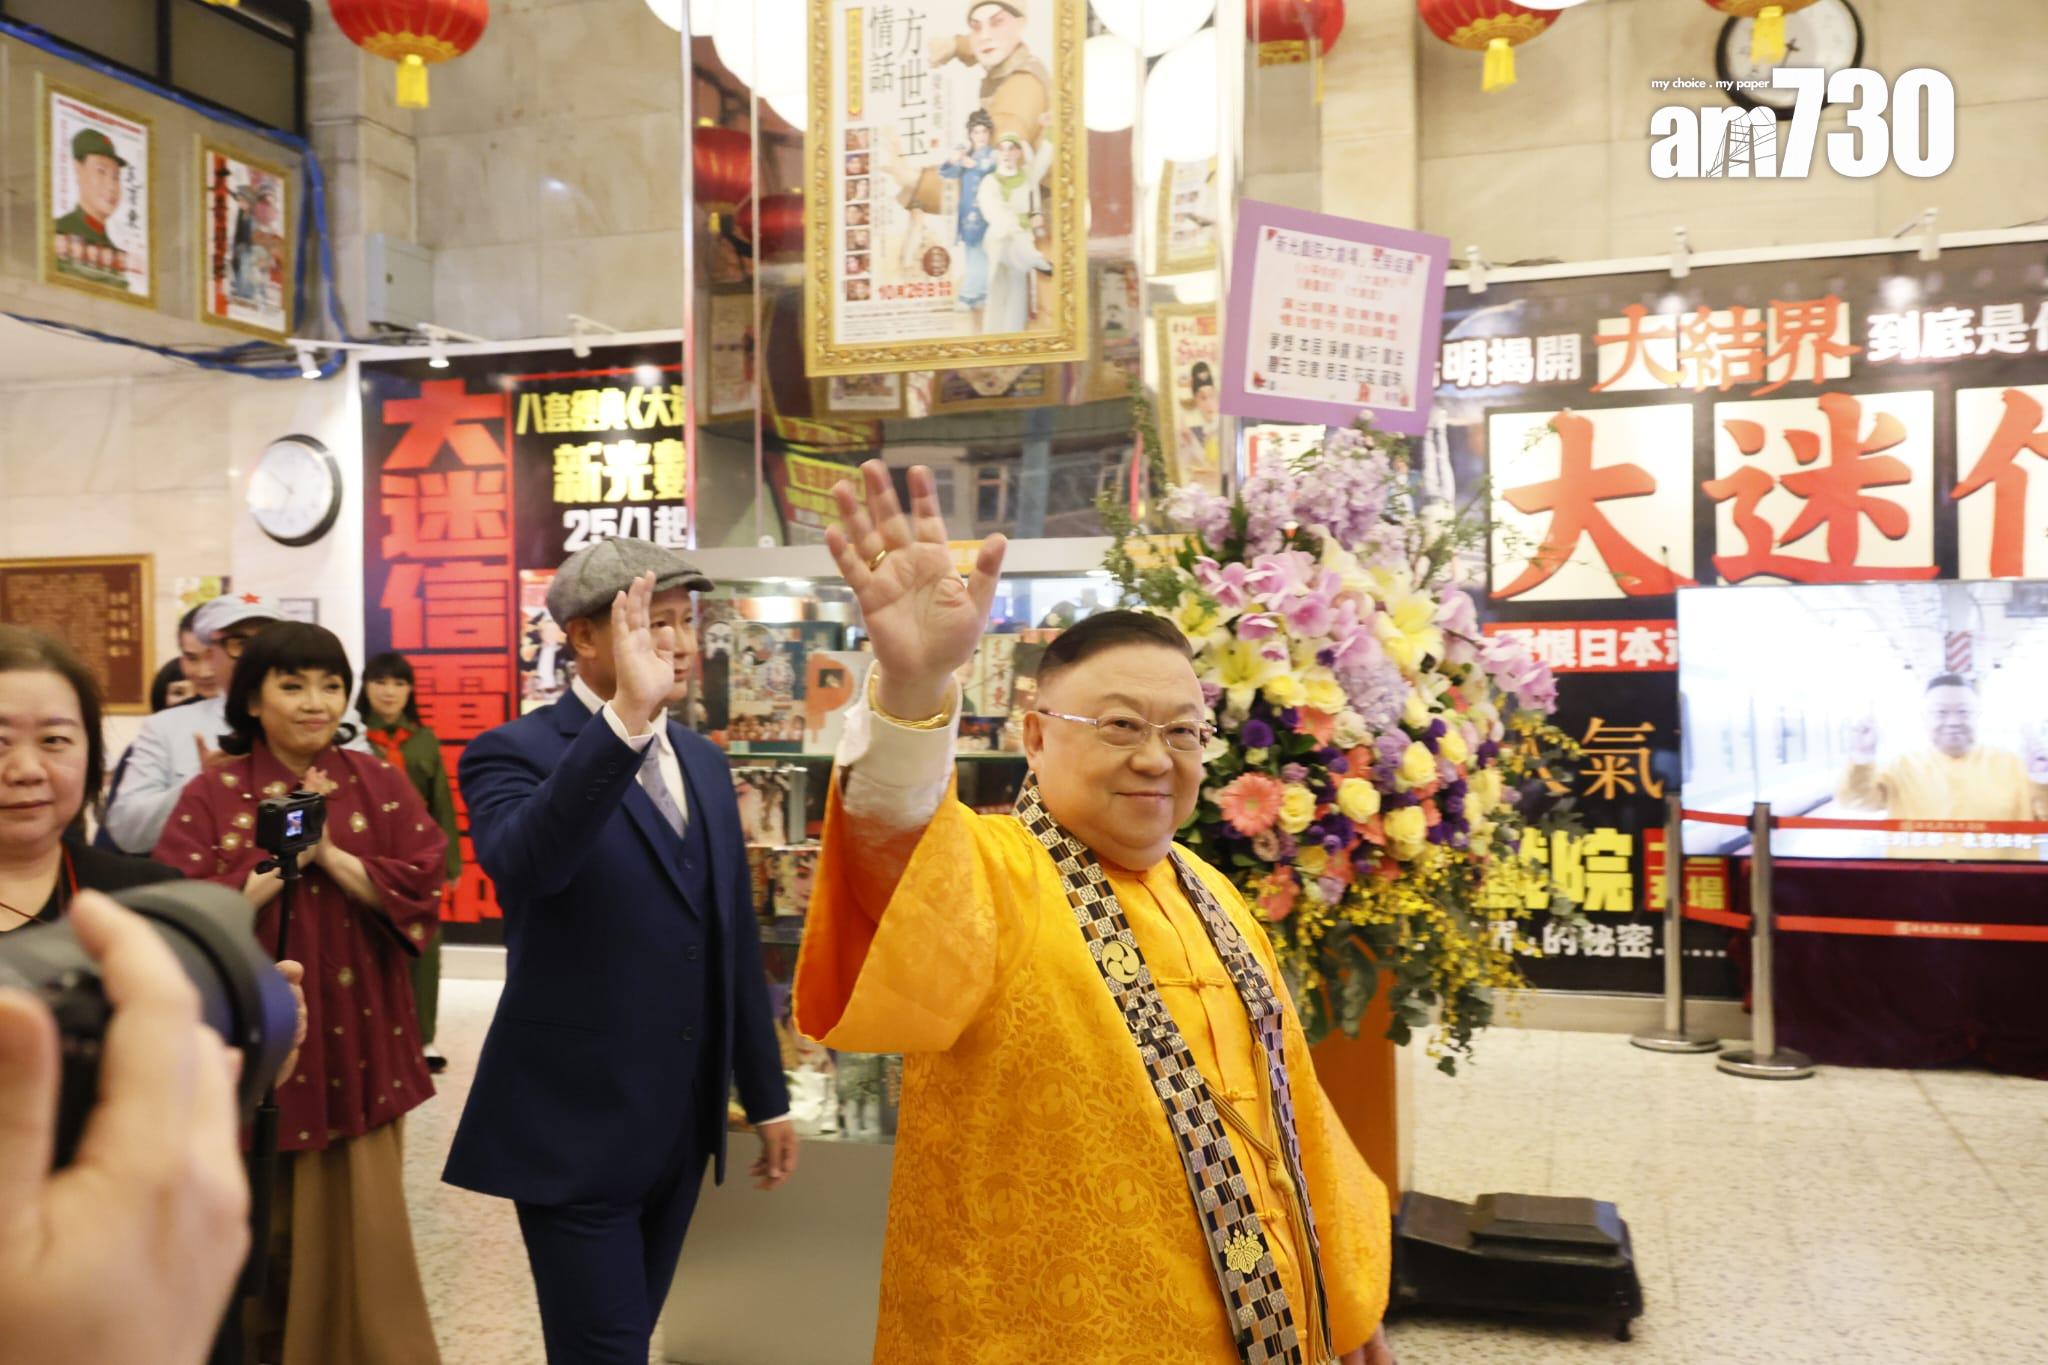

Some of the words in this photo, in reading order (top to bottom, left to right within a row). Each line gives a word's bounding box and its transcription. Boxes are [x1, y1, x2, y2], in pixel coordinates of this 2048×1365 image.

[898, 8, 928, 157] 方世玉
[1434, 333, 1582, 389] 明揭開
[1589, 296, 1863, 396] 大結界
